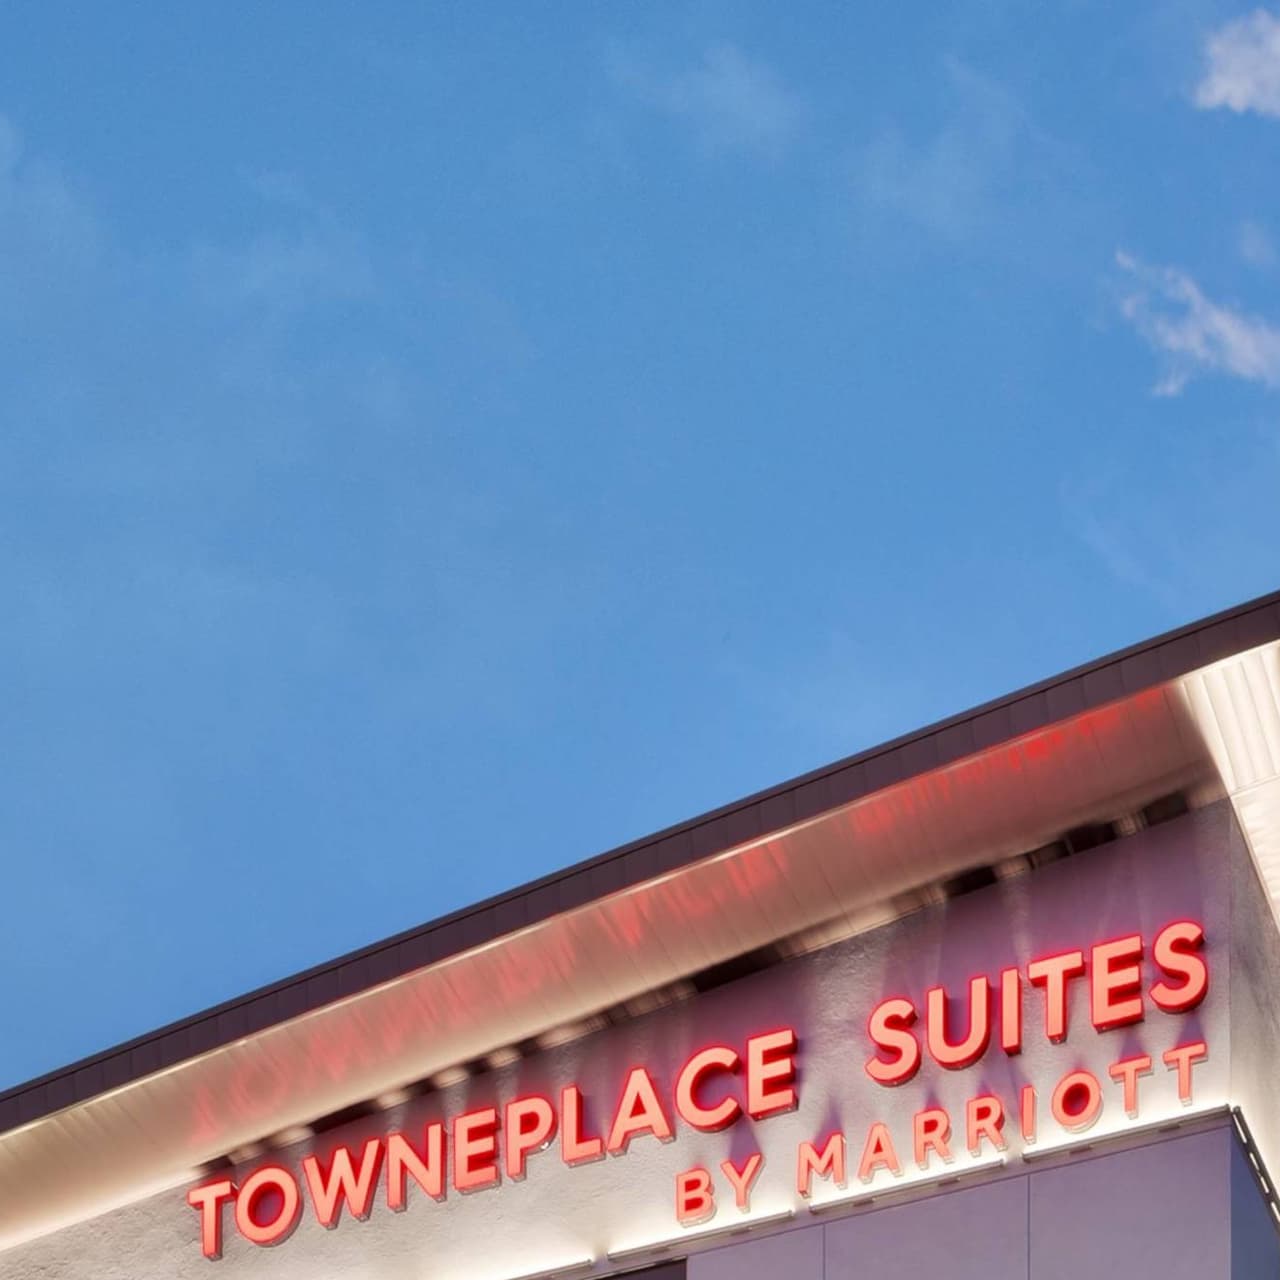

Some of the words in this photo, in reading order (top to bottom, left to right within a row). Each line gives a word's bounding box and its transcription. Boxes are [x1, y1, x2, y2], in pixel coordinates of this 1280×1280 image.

[188, 1029, 797, 1260] TOWNEPLACE
[865, 919, 1209, 1086] SUITES
[675, 1153, 762, 1227] BY
[797, 1041, 1208, 1199] MARRIOTT
